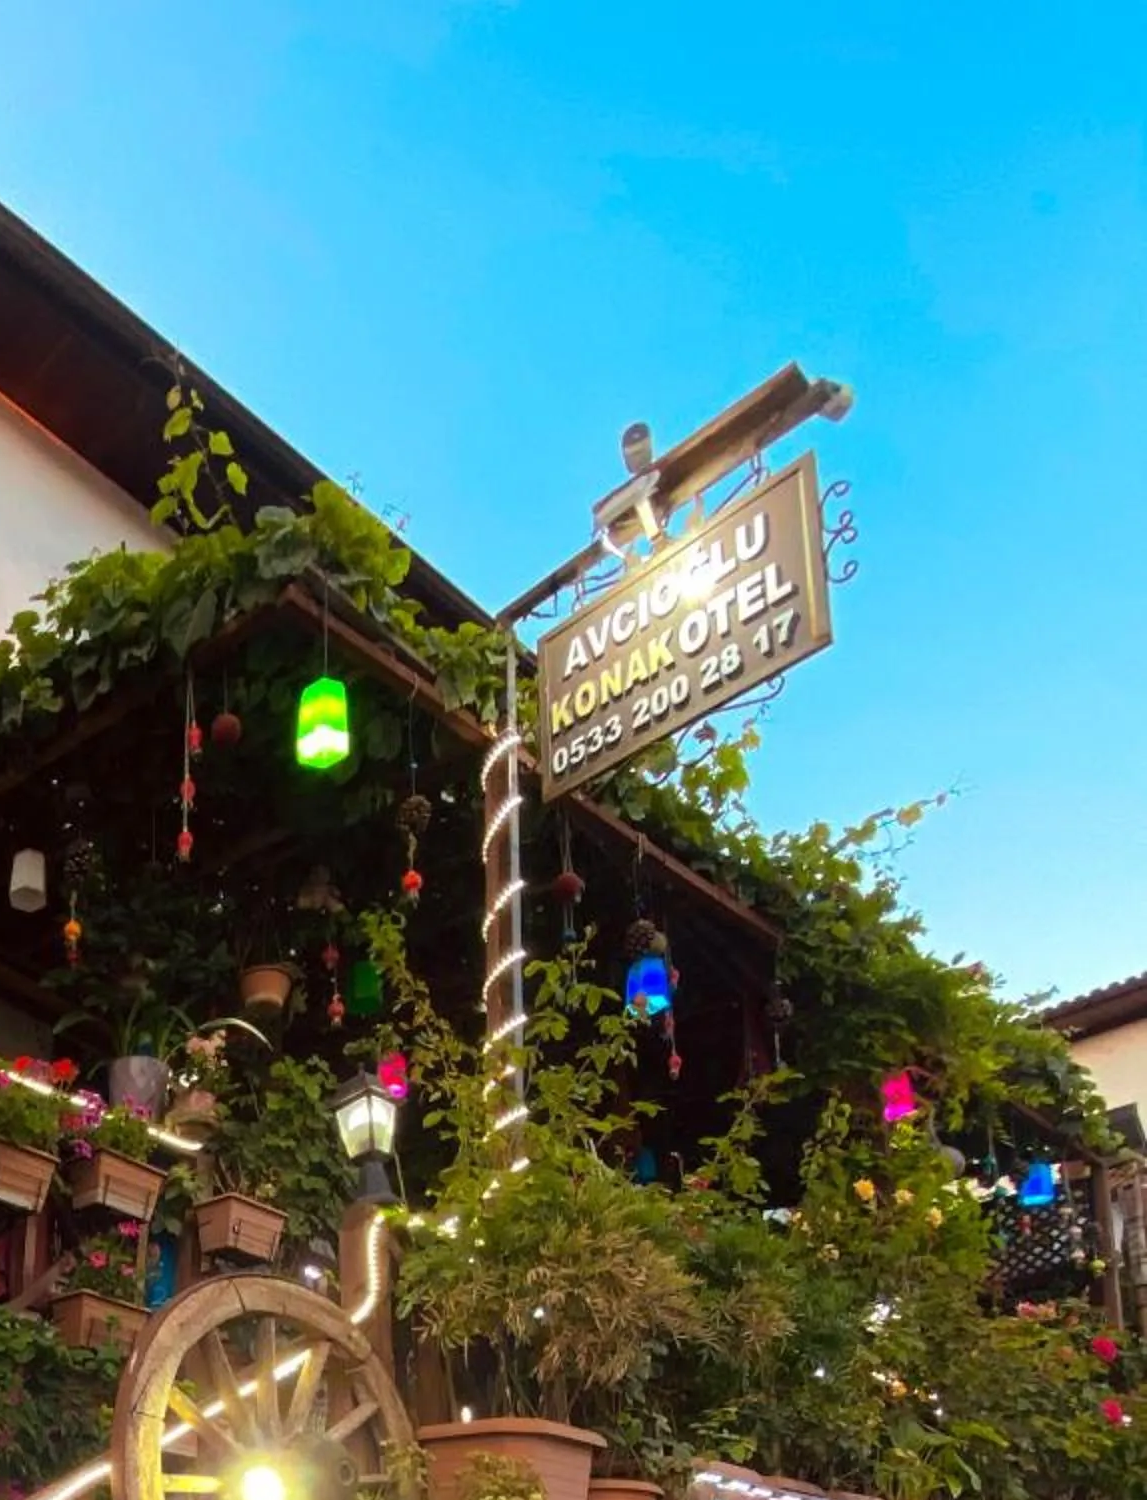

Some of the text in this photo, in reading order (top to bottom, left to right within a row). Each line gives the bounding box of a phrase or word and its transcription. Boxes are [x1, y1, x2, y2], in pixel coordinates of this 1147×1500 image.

[552, 562, 792, 735] KONAK OTEL
[552, 609, 794, 774] 0533 200 28 17
